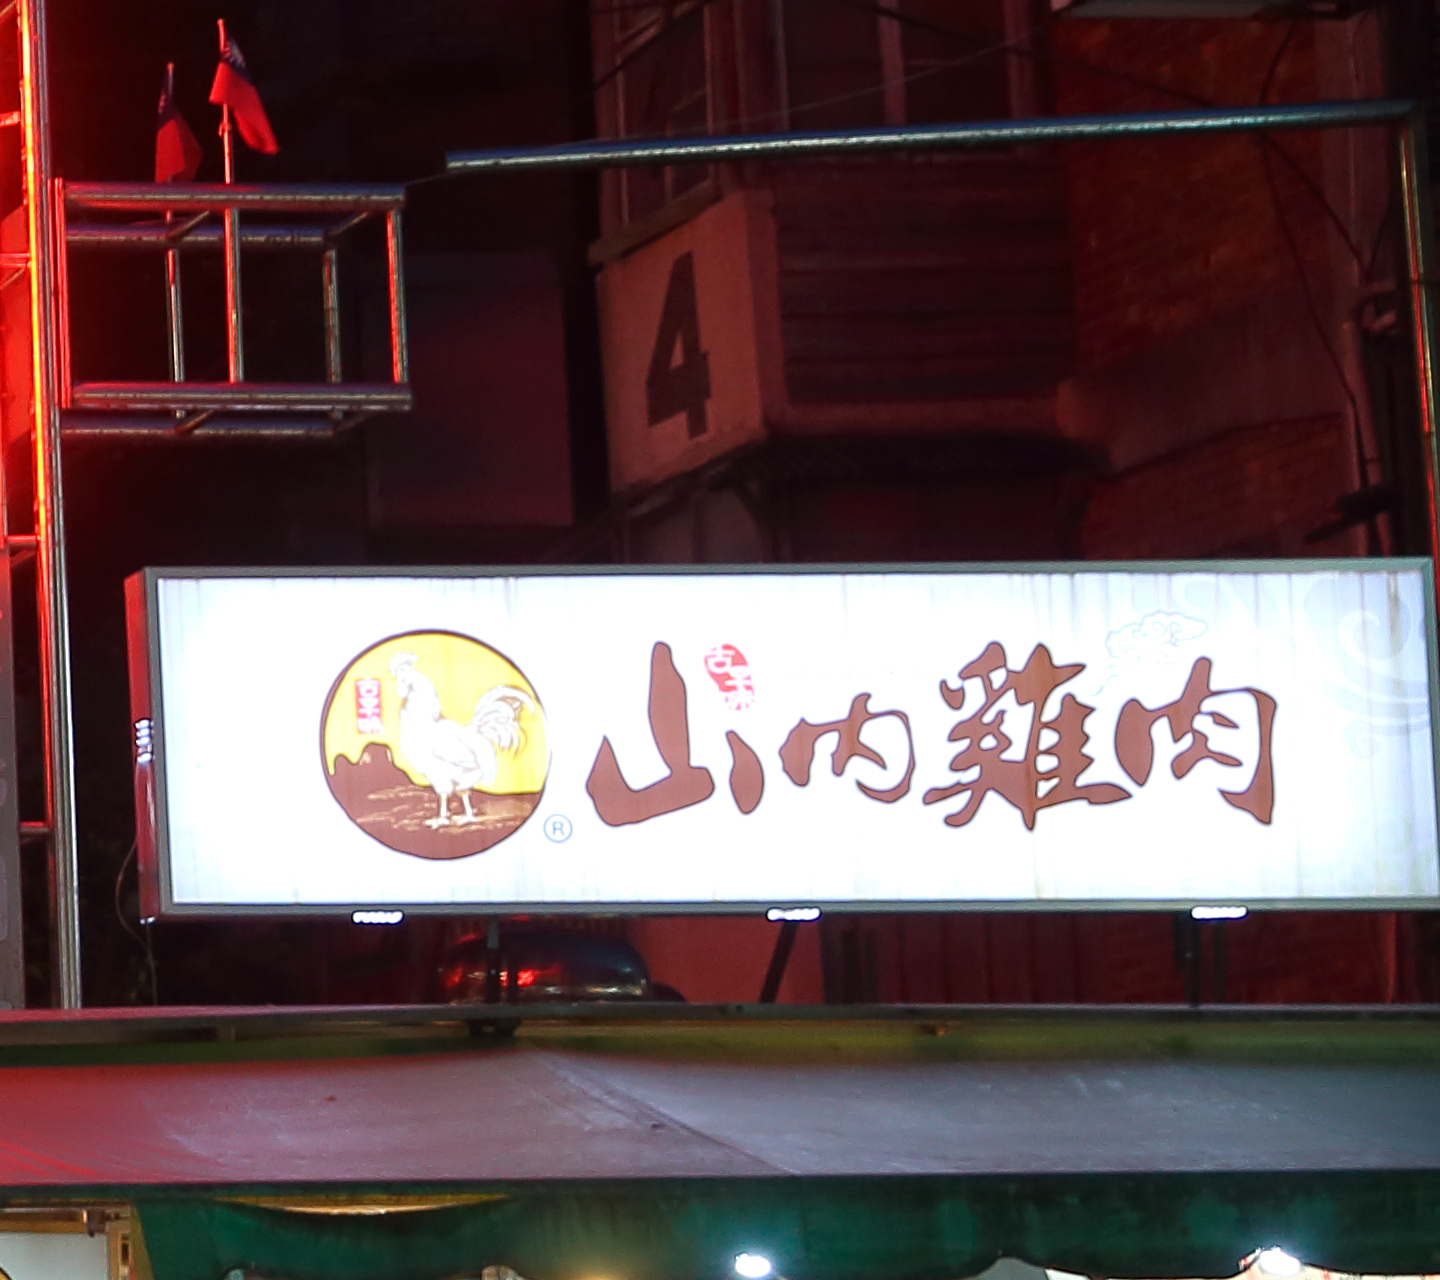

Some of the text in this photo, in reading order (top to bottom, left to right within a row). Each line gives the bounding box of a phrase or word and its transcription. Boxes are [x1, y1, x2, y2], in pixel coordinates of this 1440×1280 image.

[646, 250, 711, 439] 4
[585, 639, 1277, 832] 山內雞肉
